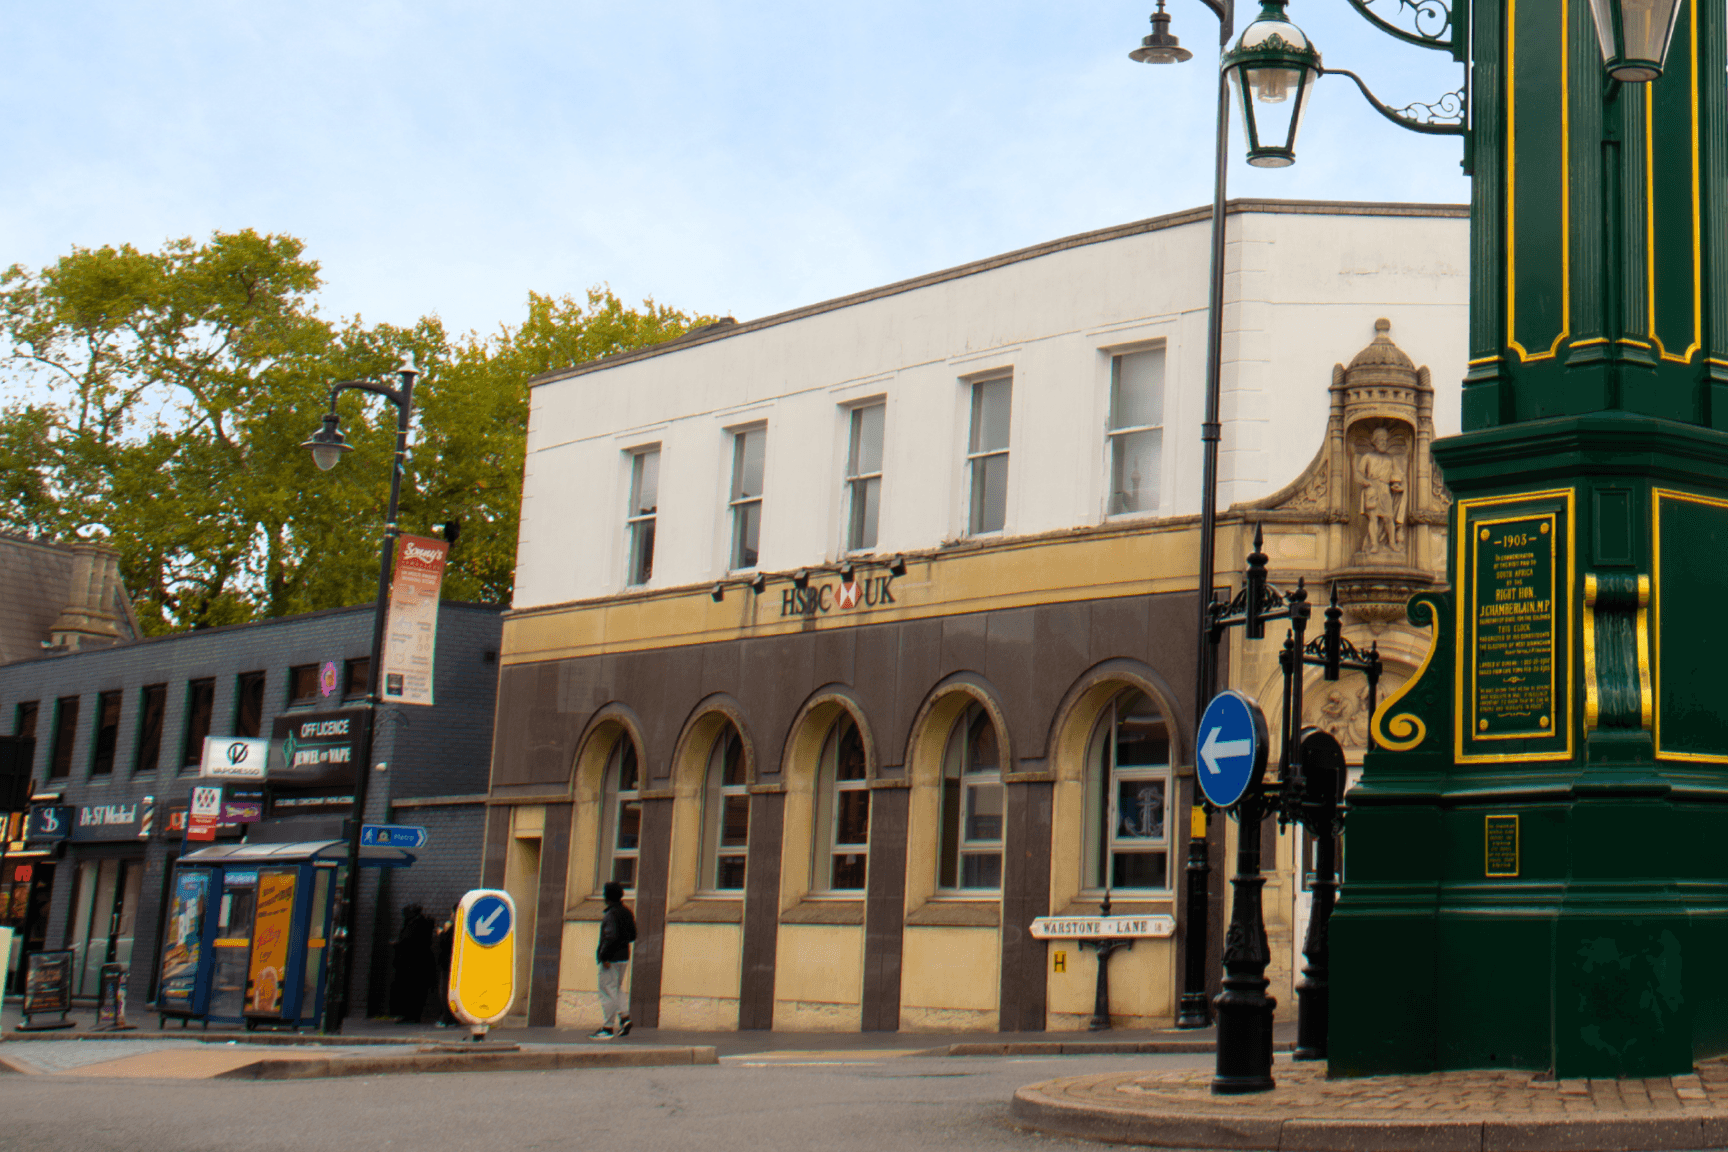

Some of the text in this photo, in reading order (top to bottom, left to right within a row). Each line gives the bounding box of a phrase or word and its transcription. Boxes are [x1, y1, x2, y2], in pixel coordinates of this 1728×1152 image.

[404, 542, 443, 564] Sonny's
[780, 576, 896, 616] HSBC UK
[1495, 588, 1517, 602] RIGHT
[293, 749, 320, 768] JEWEL
[329, 747, 351, 763] VAPE
[212, 767, 260, 776] VAPORESSO
[104, 803, 137, 824] Medical
[1043, 921, 1101, 934] WARSTONE
[1116, 920, 1148, 933] LANE
[1054, 954, 1066, 972] H
